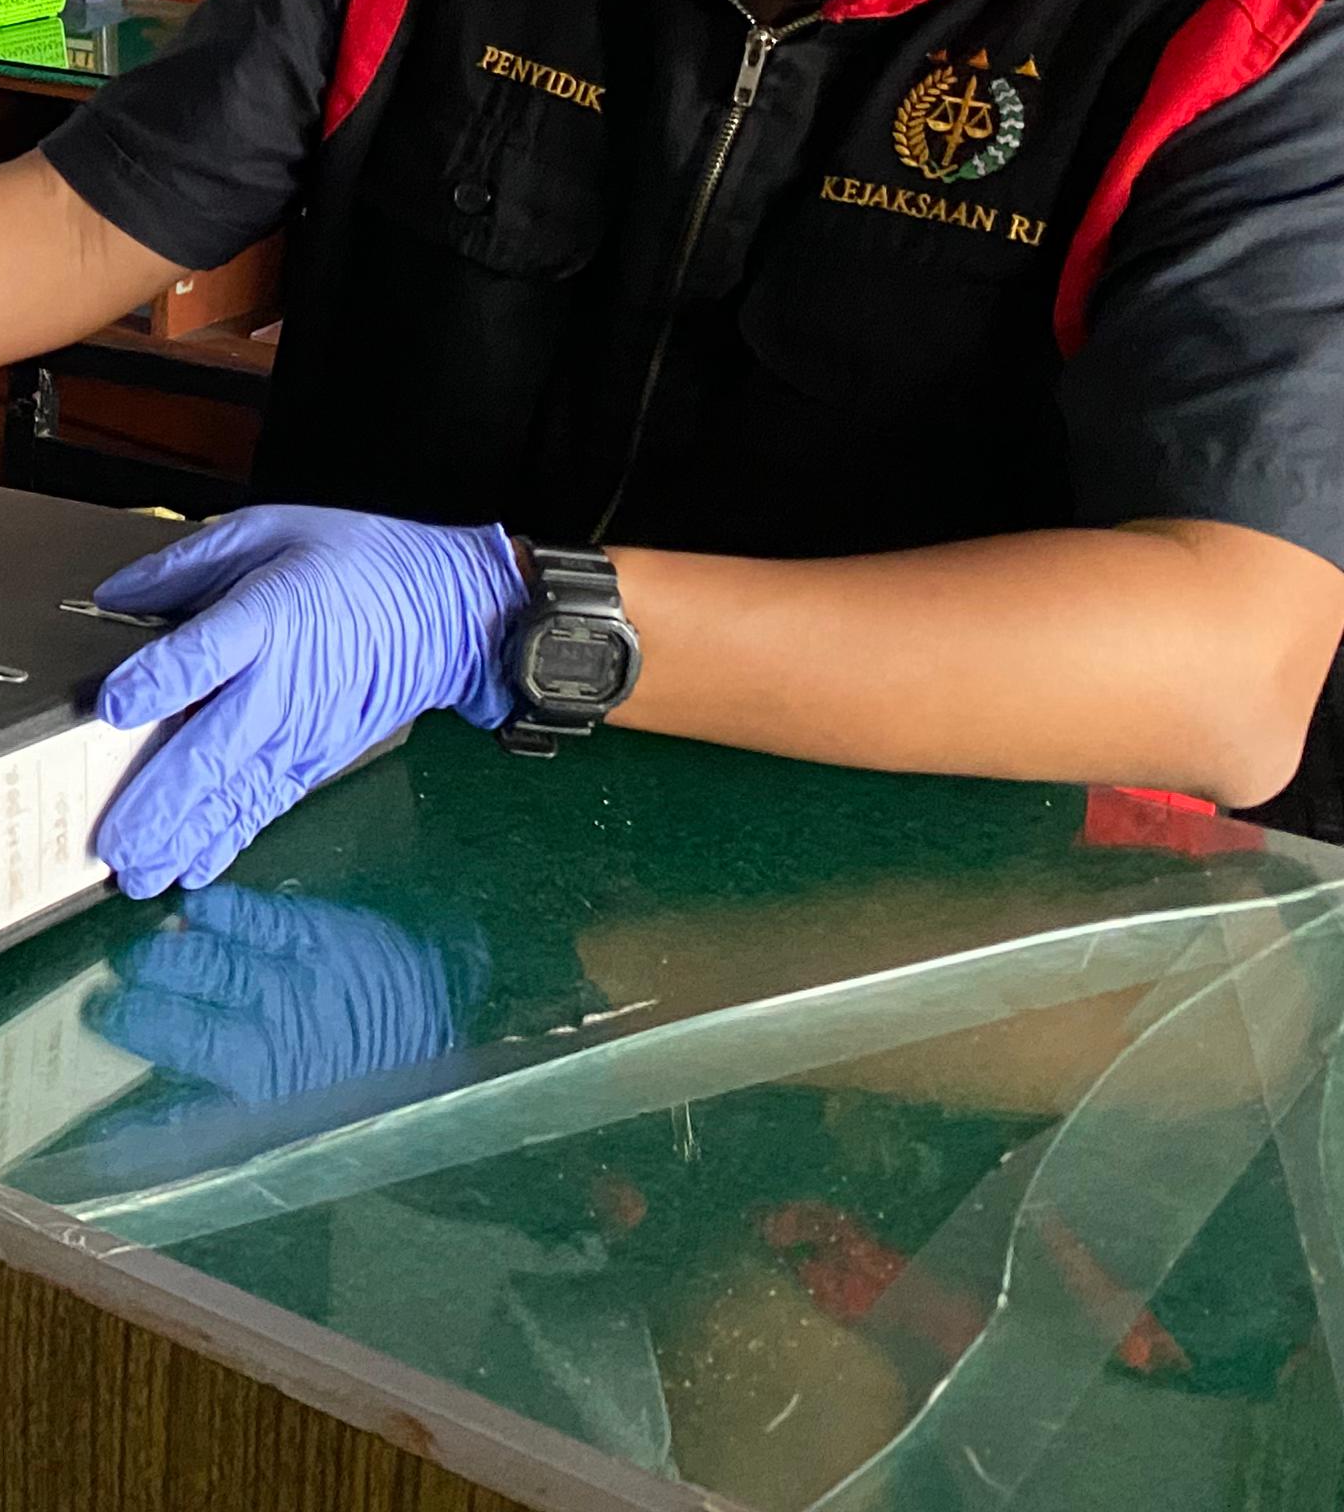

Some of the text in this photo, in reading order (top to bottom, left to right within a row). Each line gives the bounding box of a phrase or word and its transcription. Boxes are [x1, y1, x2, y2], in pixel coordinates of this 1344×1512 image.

[479, 45, 607, 114] PENYIDIK
[820, 175, 1048, 247] KEJAKSAAN RI
